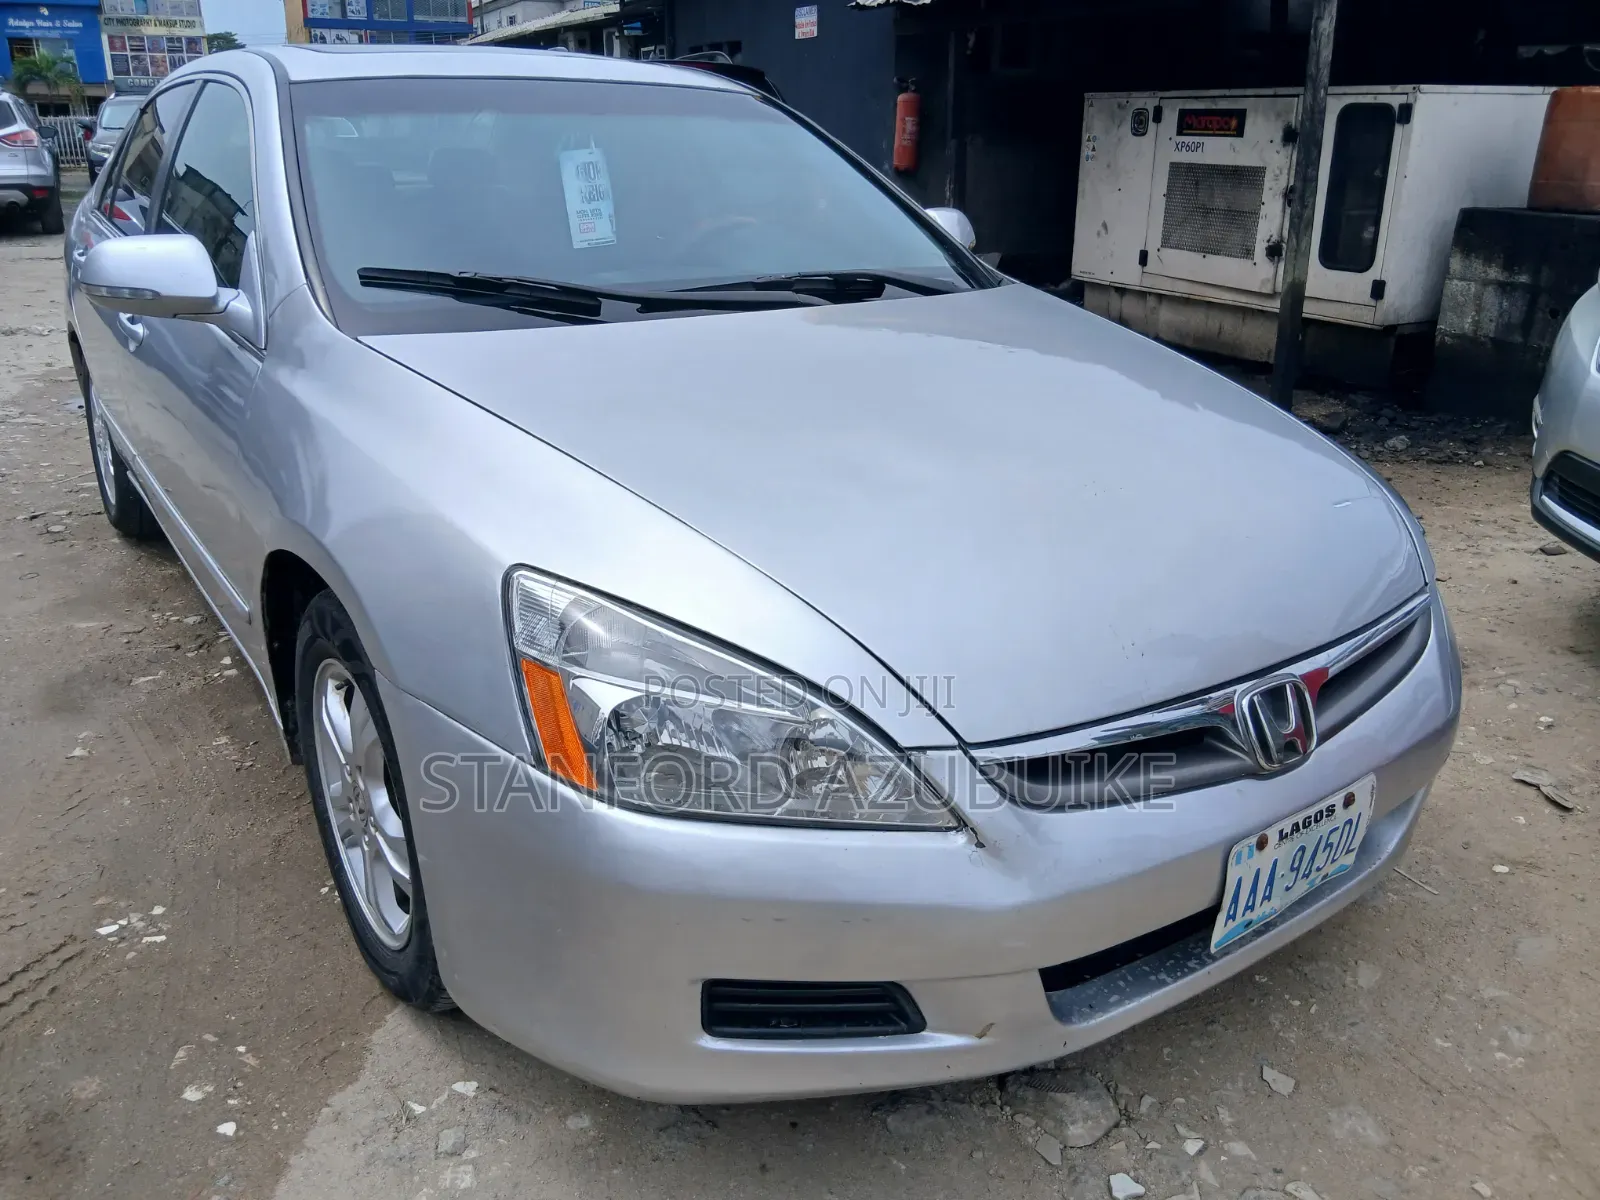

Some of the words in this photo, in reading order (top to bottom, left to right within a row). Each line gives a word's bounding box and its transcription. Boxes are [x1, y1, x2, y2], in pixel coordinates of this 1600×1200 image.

[63, 20, 83, 28] Salon
[104, 17, 115, 26] CITY
[116, 18, 152, 27] PHOTOGRAPHY
[179, 19, 196, 29] STUDIO
[1174, 140, 1205, 153] XP60P1
[1278, 803, 1336, 842] LAGOS
